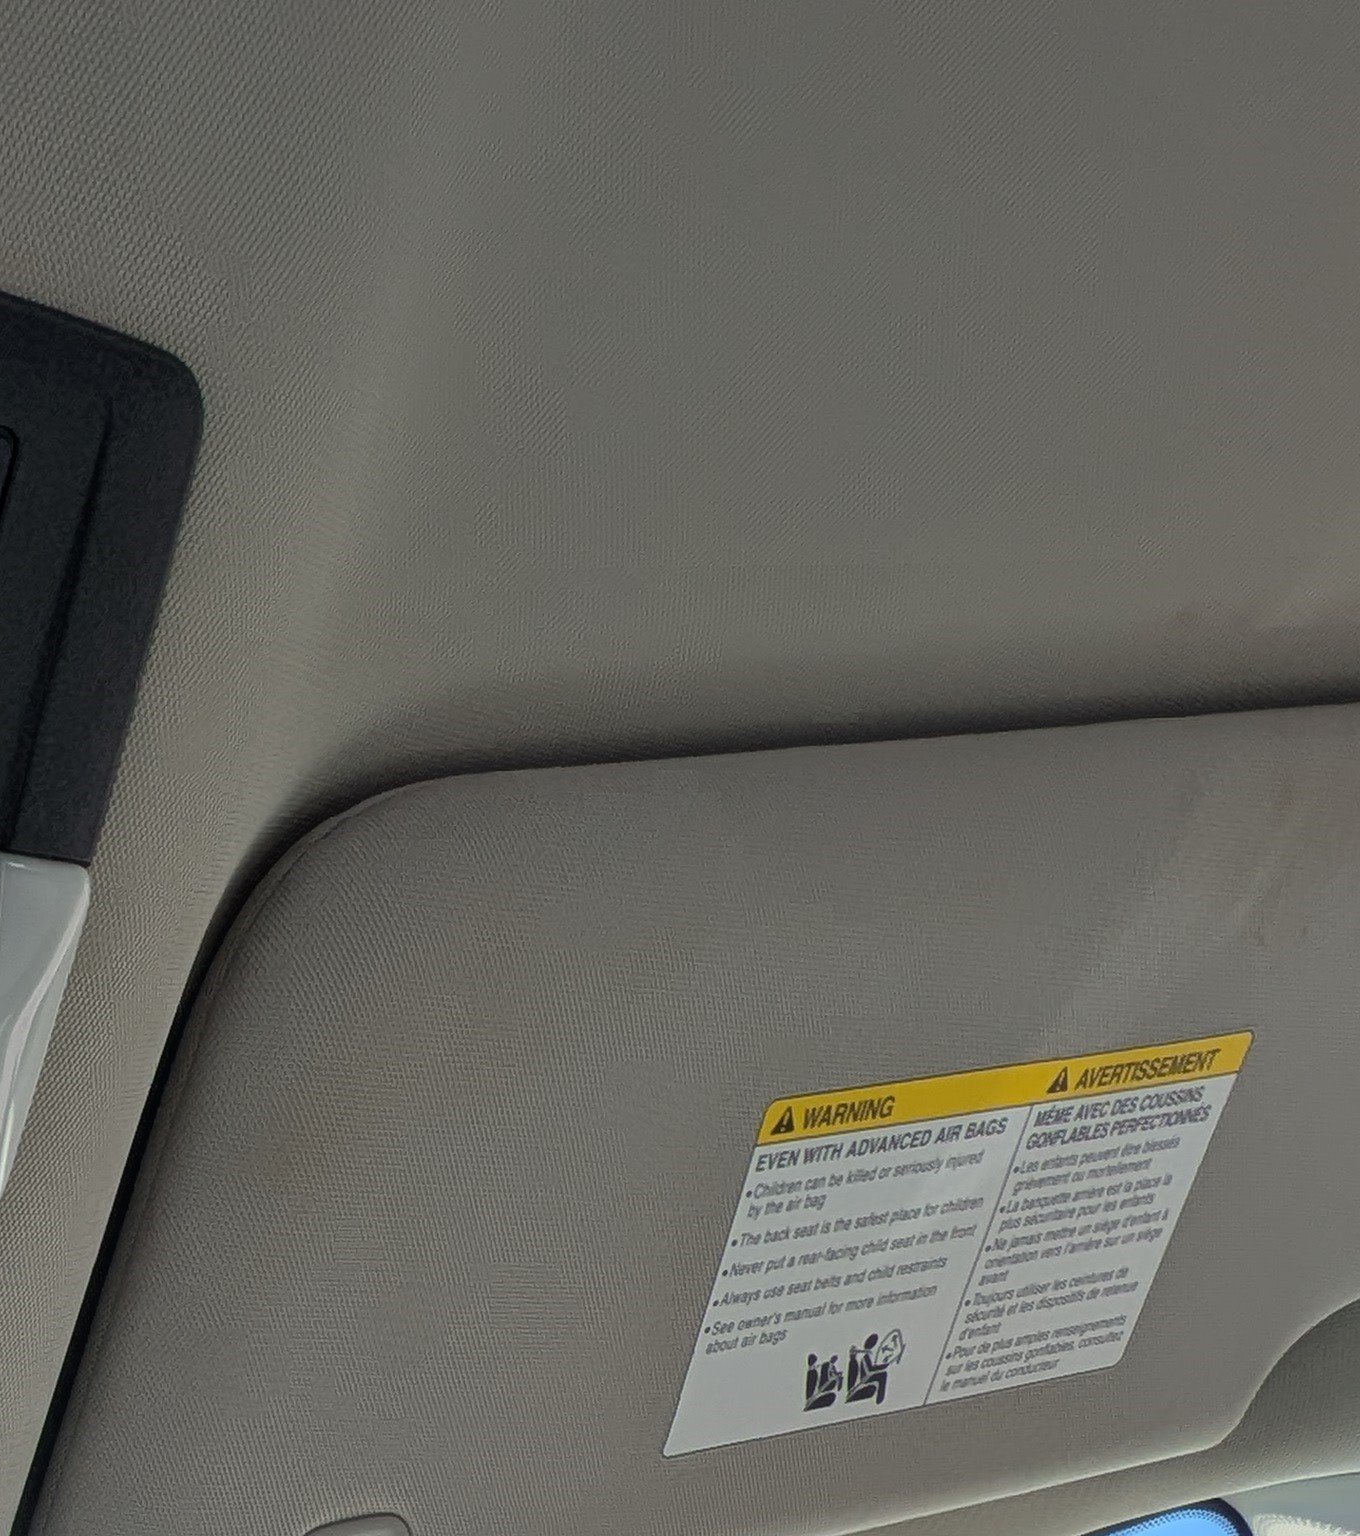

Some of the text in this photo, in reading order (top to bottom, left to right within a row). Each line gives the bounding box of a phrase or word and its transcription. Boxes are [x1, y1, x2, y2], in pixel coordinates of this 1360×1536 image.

[1074, 1048, 1221, 1090] AVERTISSEMENT
[803, 1095, 895, 1129] WARNING
[1074, 1100, 1111, 1121] AVEC
[1110, 1096, 1139, 1116] DES
[755, 1117, 1008, 1172] EVEN WITH ADVANCED AIR BAGS
[753, 1180, 803, 1200] Children
[804, 1176, 826, 1191] can
[828, 1174, 844, 1187] be
[846, 1167, 878, 1184] killed
[878, 1167, 892, 1180] or
[740, 1197, 984, 1247] The back seat is the safest place for children
[747, 1194, 827, 1221] by the air bag
[729, 1224, 977, 1277] Never put a rear-facing child seat in the front
[719, 1257, 948, 1307] Always use seat belts and child restraints
[711, 1285, 937, 1336] See owner's manual for more information
[705, 1329, 788, 1355] about air bags
